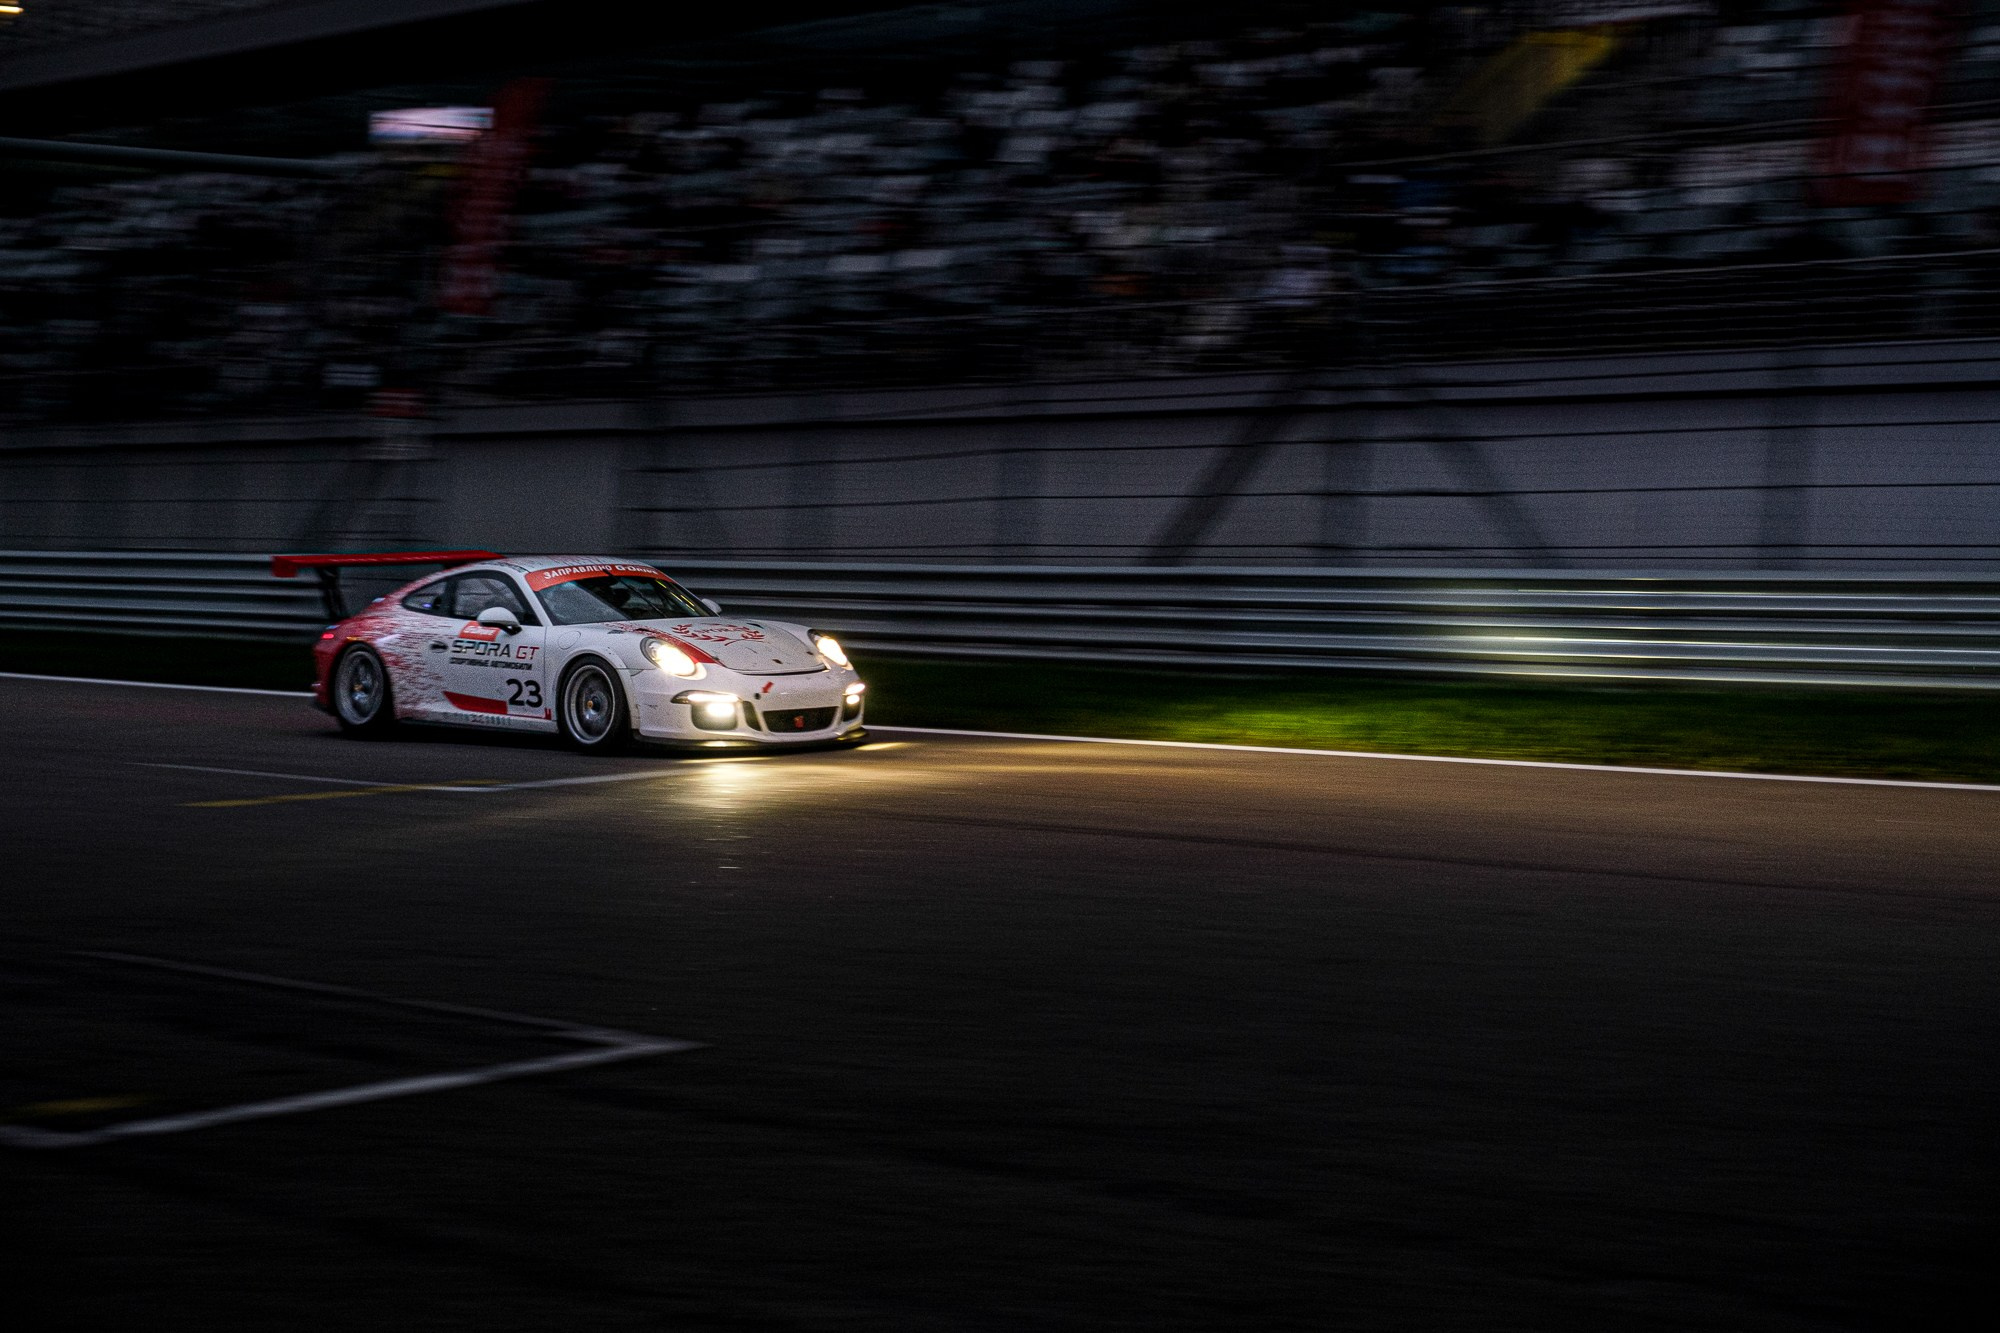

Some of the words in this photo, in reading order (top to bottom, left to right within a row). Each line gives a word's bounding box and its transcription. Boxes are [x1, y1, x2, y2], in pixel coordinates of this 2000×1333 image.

[544, 564, 612, 580] ЗАПРАВЛЕНО
[452, 640, 511, 658] SPORA
[516, 645, 540, 660] GT
[506, 678, 543, 708] 23
